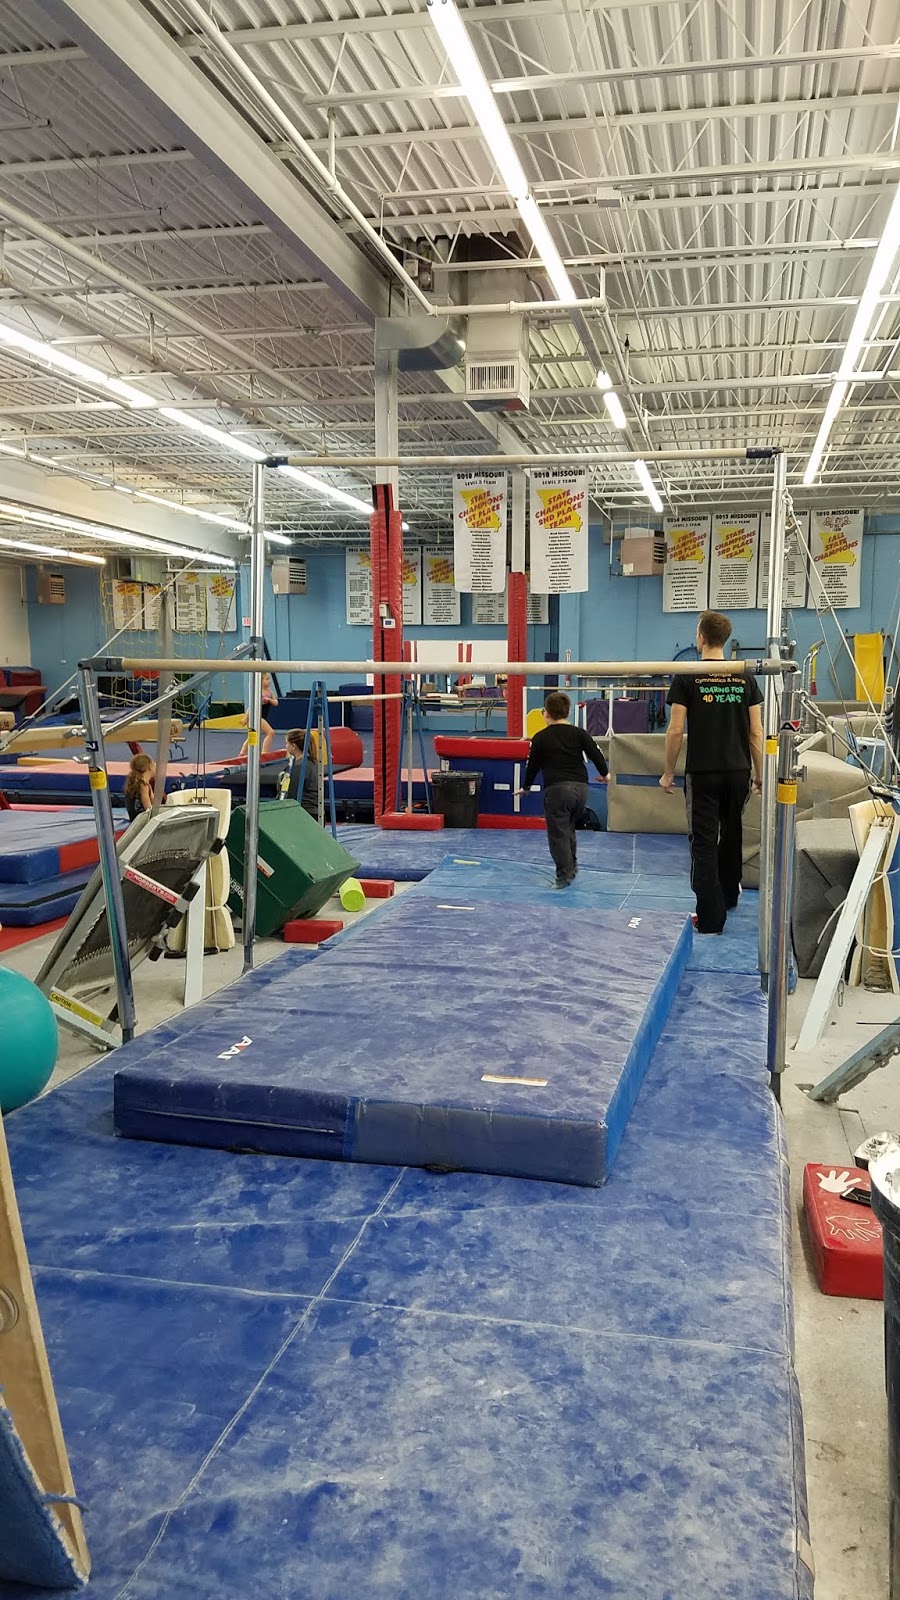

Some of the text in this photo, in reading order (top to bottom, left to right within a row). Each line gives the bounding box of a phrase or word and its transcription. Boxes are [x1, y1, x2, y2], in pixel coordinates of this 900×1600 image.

[551, 470, 586, 478] MISSOURI
[470, 490, 491, 505] STATE
[548, 489, 571, 505] STATE
[458, 494, 504, 518] CHAMPIONS
[534, 492, 585, 519] CHAMPIONS
[465, 504, 500, 524] 1ST PLACE
[538, 502, 582, 526] 2ND PLACE
[472, 516, 492, 528] TEAM
[548, 515, 572, 529] TEAM
[678, 531, 696, 542] STATE
[715, 531, 756, 551] CHAMPIONS
[726, 528, 745, 540] STATE
[667, 533, 707, 554] CHAMPIONS
[684, 540, 704, 552] PLACE
[732, 538, 754, 550] PLACE
[825, 538, 847, 551] STATE
[678, 551, 696, 561] TEAM
[726, 548, 745, 559] TEAM
[814, 540, 858, 562] CHAMPIONS
[702, 694, 742, 703] 40 YEARS
[52, 993, 72, 1007] CAUTION
